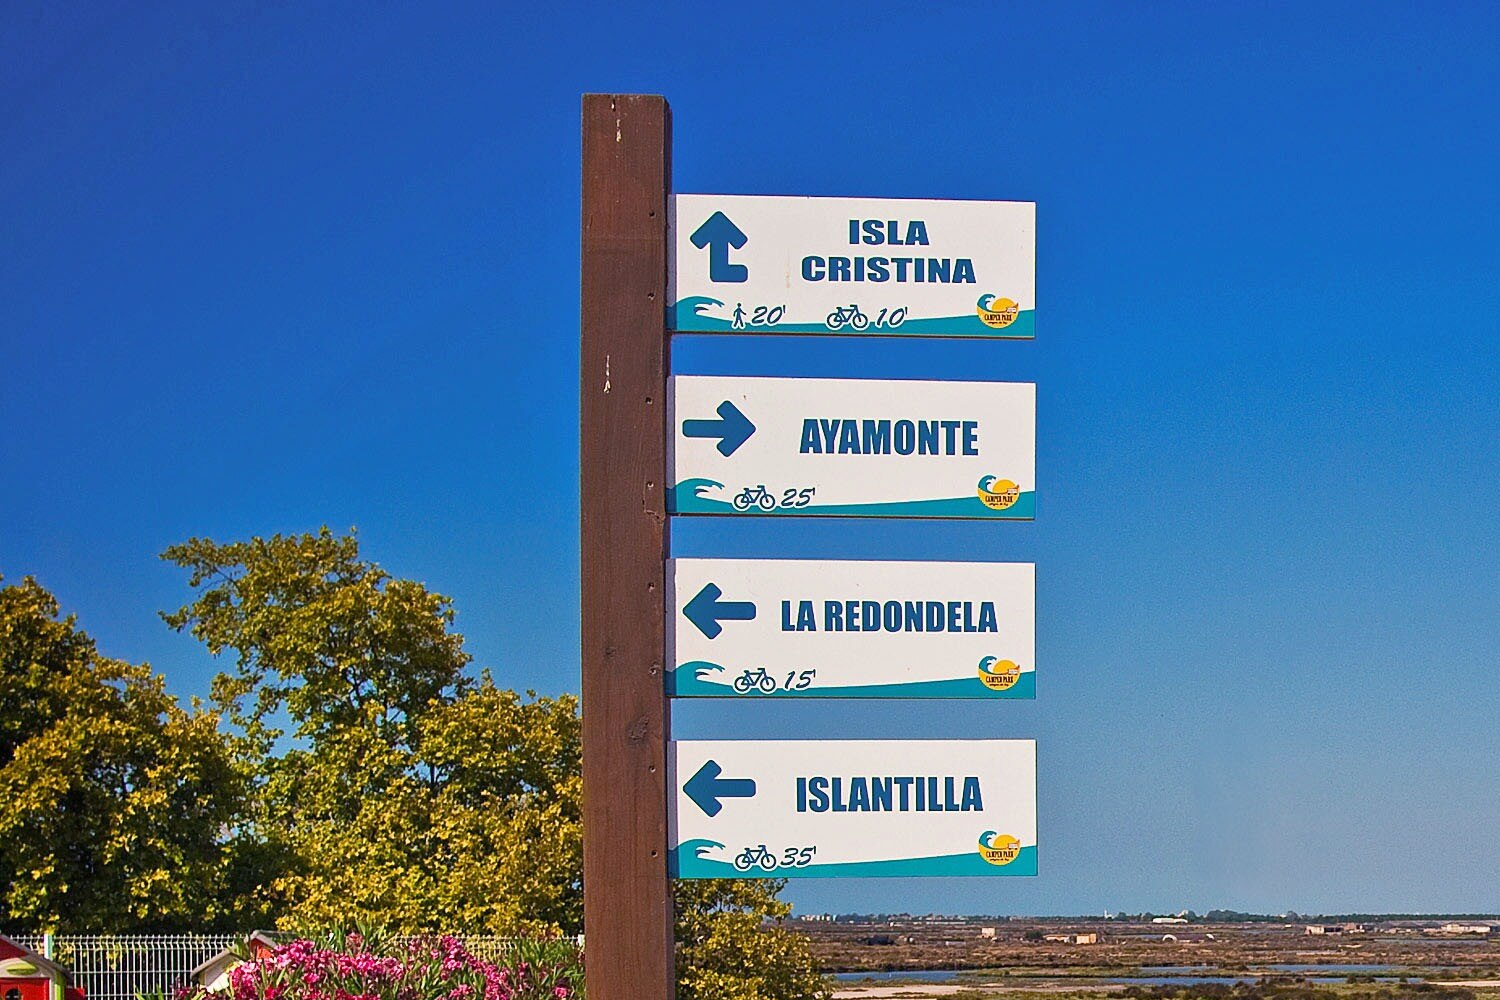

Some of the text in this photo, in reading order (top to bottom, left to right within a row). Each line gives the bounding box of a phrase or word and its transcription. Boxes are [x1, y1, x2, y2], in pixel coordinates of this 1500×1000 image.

[849, 219, 930, 246] ISLA
[801, 256, 977, 284] CRISTINA
[751, 305, 786, 324] 20'
[874, 306, 908, 326] 10'
[799, 418, 979, 456] AYAMONTE
[781, 600, 999, 633] LA REDONDELA
[796, 776, 984, 812] ISLANTILLA
